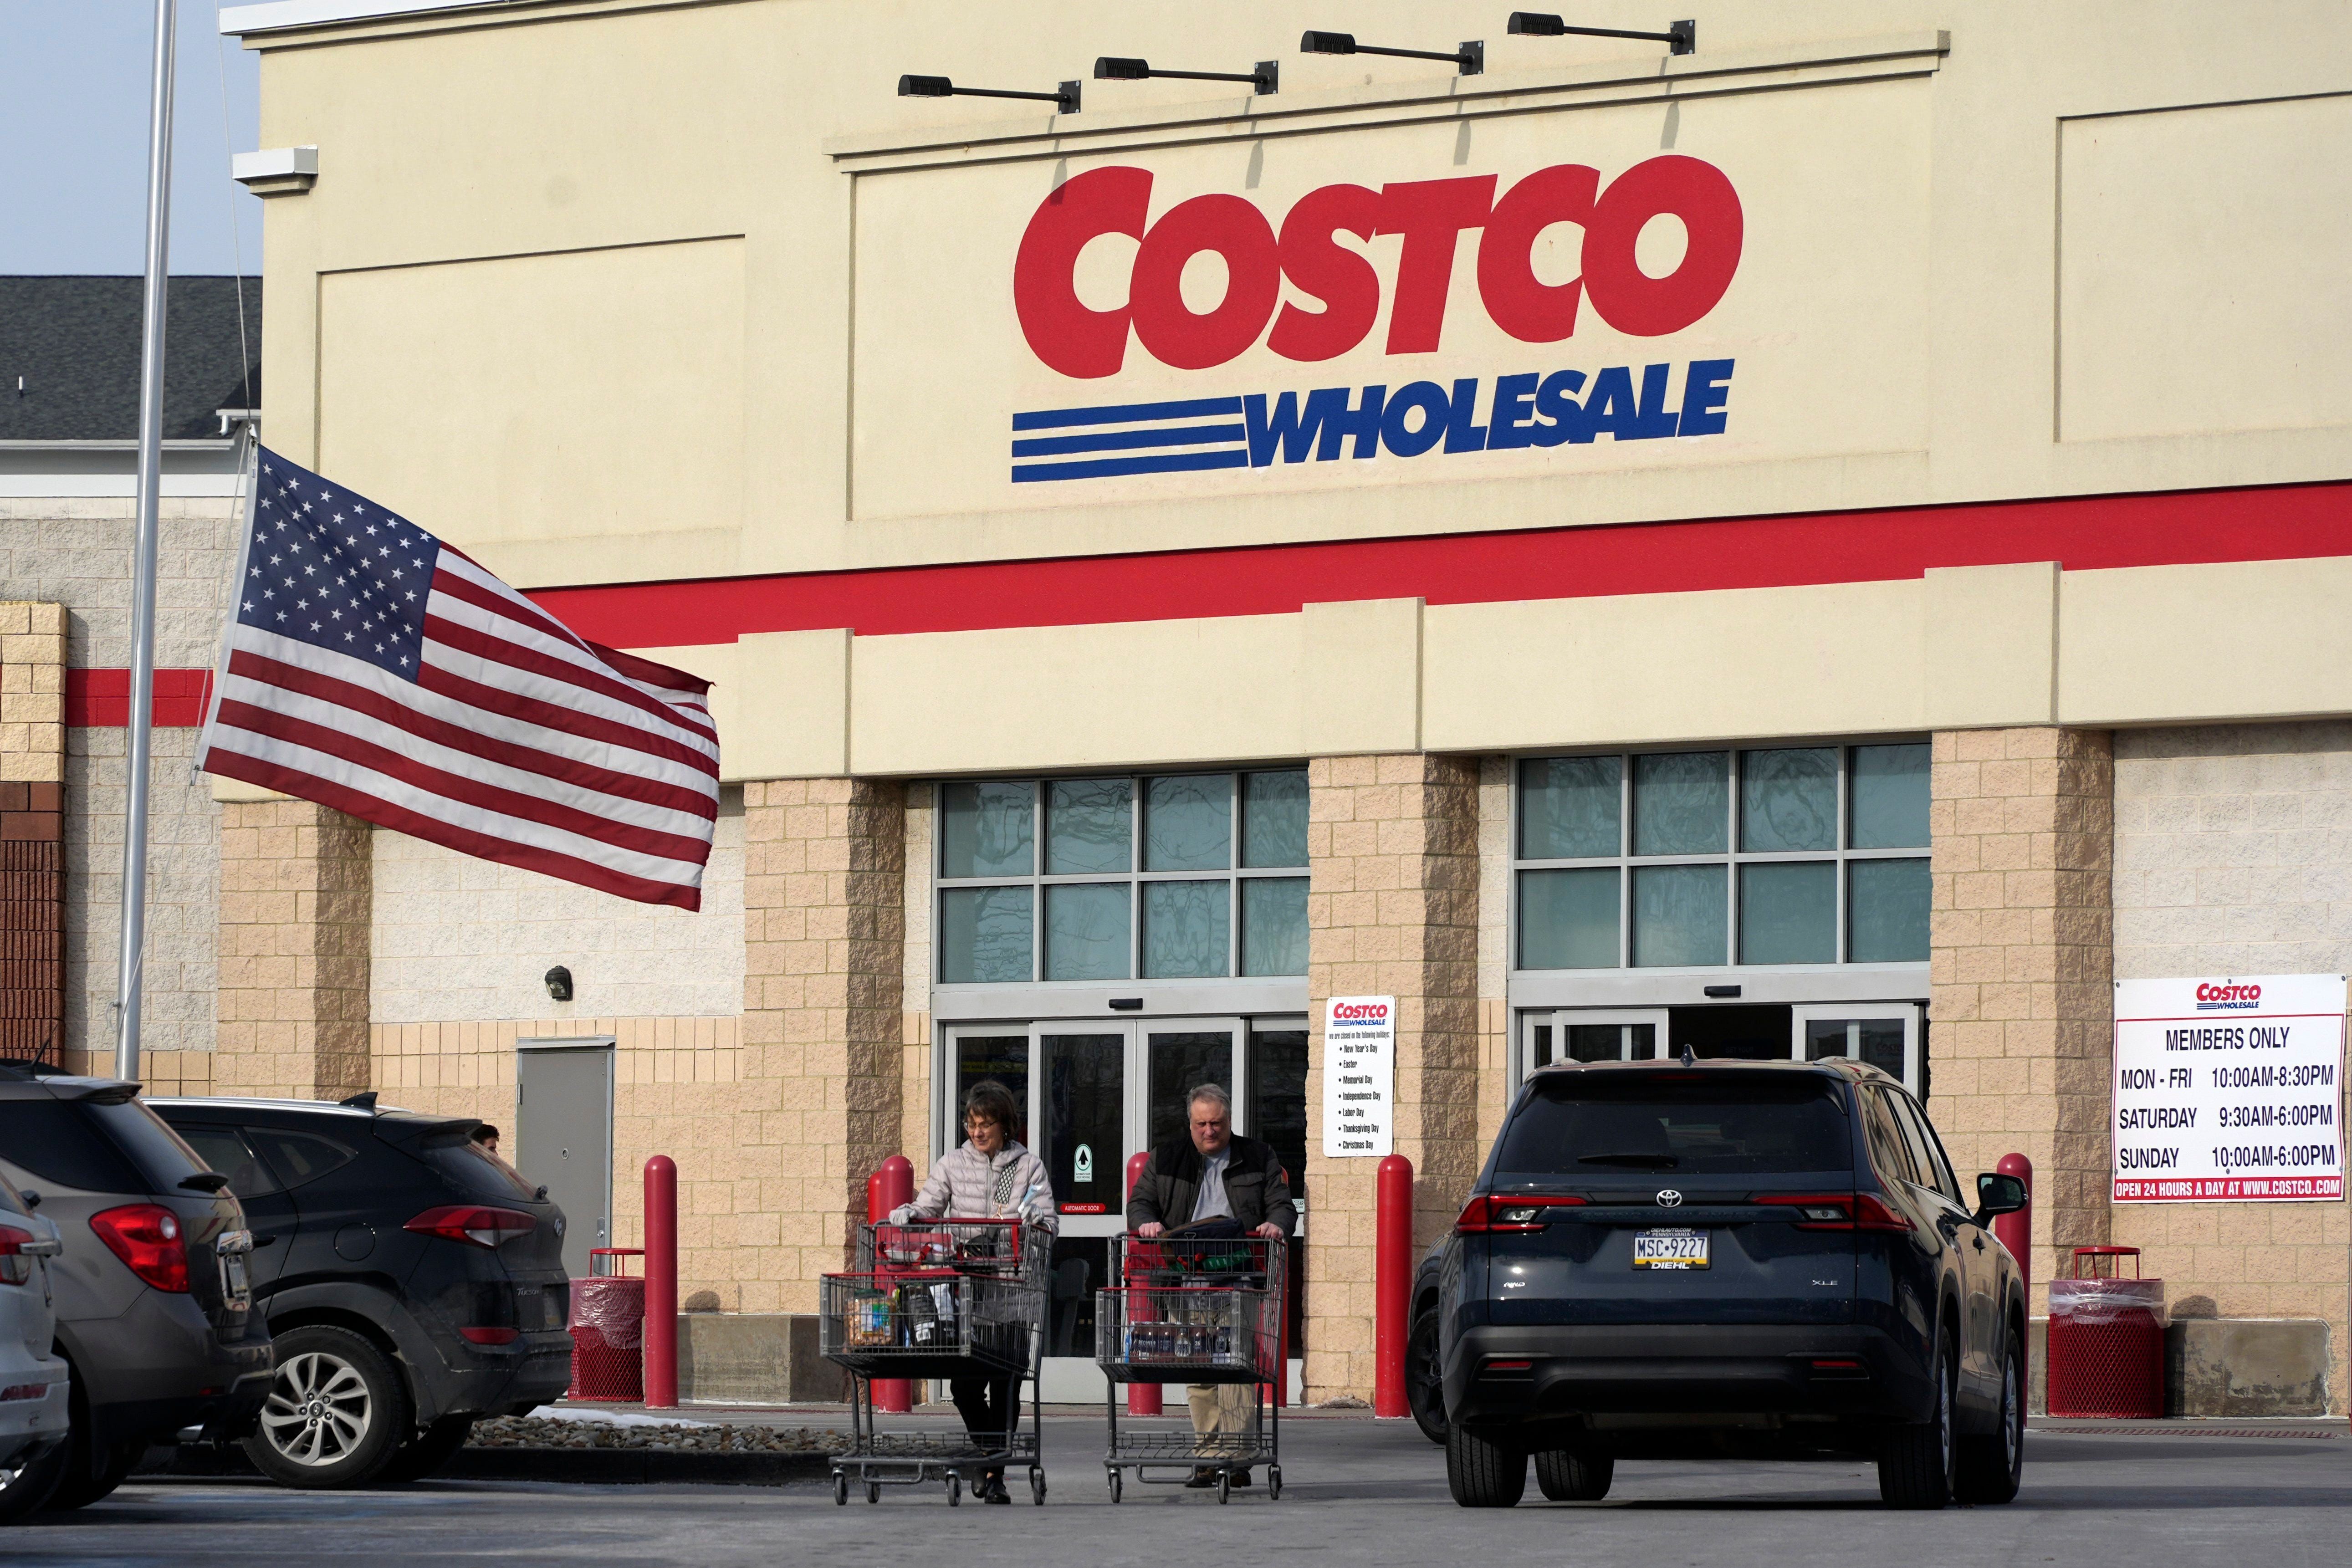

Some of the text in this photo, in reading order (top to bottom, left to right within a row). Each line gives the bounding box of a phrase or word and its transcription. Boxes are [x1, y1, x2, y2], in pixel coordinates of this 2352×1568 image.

[1013, 154, 1744, 378] COSTCO
[1243, 358, 1735, 468] WHOLESALE
[2196, 983, 2261, 1001] COSTCO
[1333, 1003, 1387, 1019] COSTCO
[1362, 1032, 1375, 1040] following
[2166, 1027, 2290, 1051] MEMBERS ONLY
[1344, 1045, 1353, 1053] New
[1355, 1044, 1369, 1052] Year's
[1343, 1060, 1357, 1068] Easter
[1343, 1075, 1364, 1084] Memorial
[2121, 1069, 2155, 1089] MON
[2169, 1068, 2192, 1088] FRI
[2212, 1065, 2334, 1088] 10:00AM-8:30PM
[1343, 1092, 1371, 1101] Independence
[1343, 1108, 1355, 1116] Labor
[2120, 1105, 2332, 1129] SATURDAY 9:30AM-6:00PM
[1343, 1124, 1370, 1134] Thanksgiving
[1343, 1141, 1364, 1149] Christmas
[2120, 1145, 2335, 1169] SUNDAY 10:00AM-6:00PM
[2116, 1180, 2340, 1197] OPEN 24 HOURS A DAY AT WWW.COSTCO.COM
